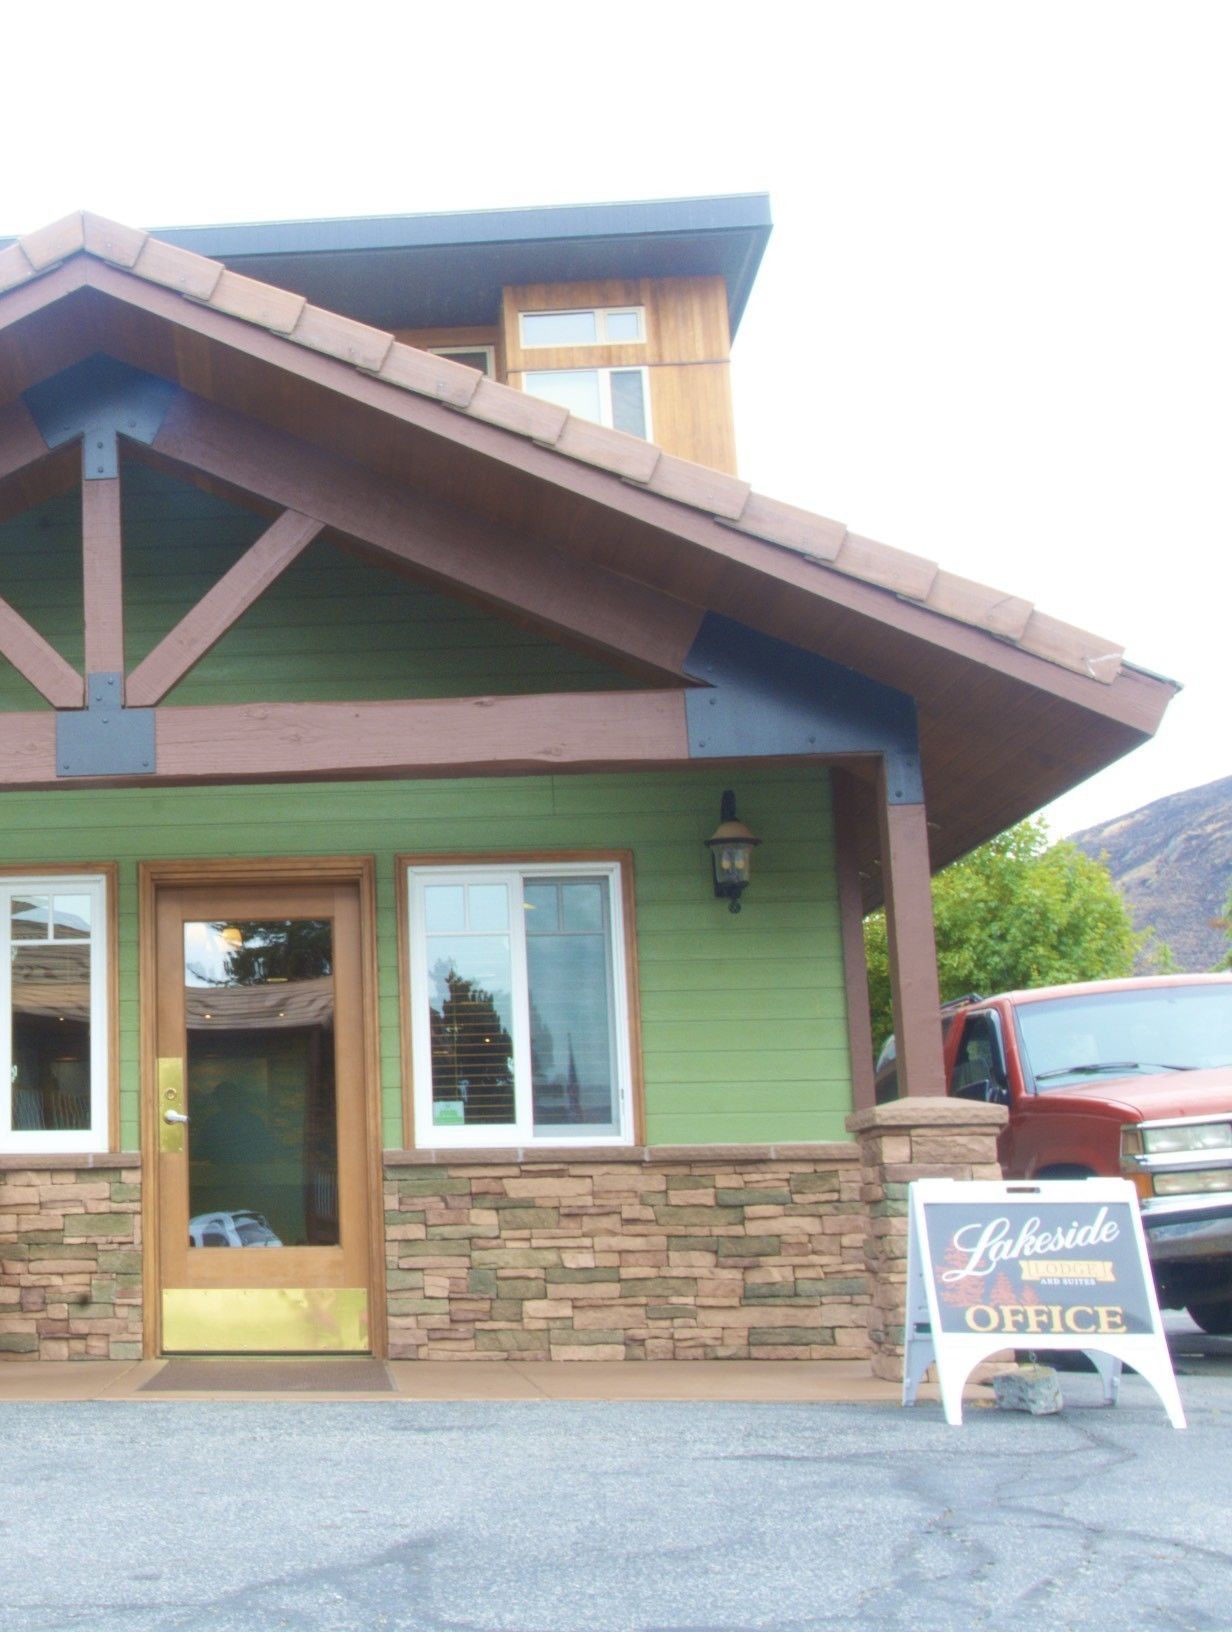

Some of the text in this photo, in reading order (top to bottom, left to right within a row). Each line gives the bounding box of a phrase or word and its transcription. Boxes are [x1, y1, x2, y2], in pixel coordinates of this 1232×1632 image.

[942, 1206, 1120, 1281] Lakeside
[1033, 1262, 1098, 1275] LODGE
[1040, 1278, 1096, 1286] AND SUITES
[965, 1304, 1127, 1333] OFFICE
